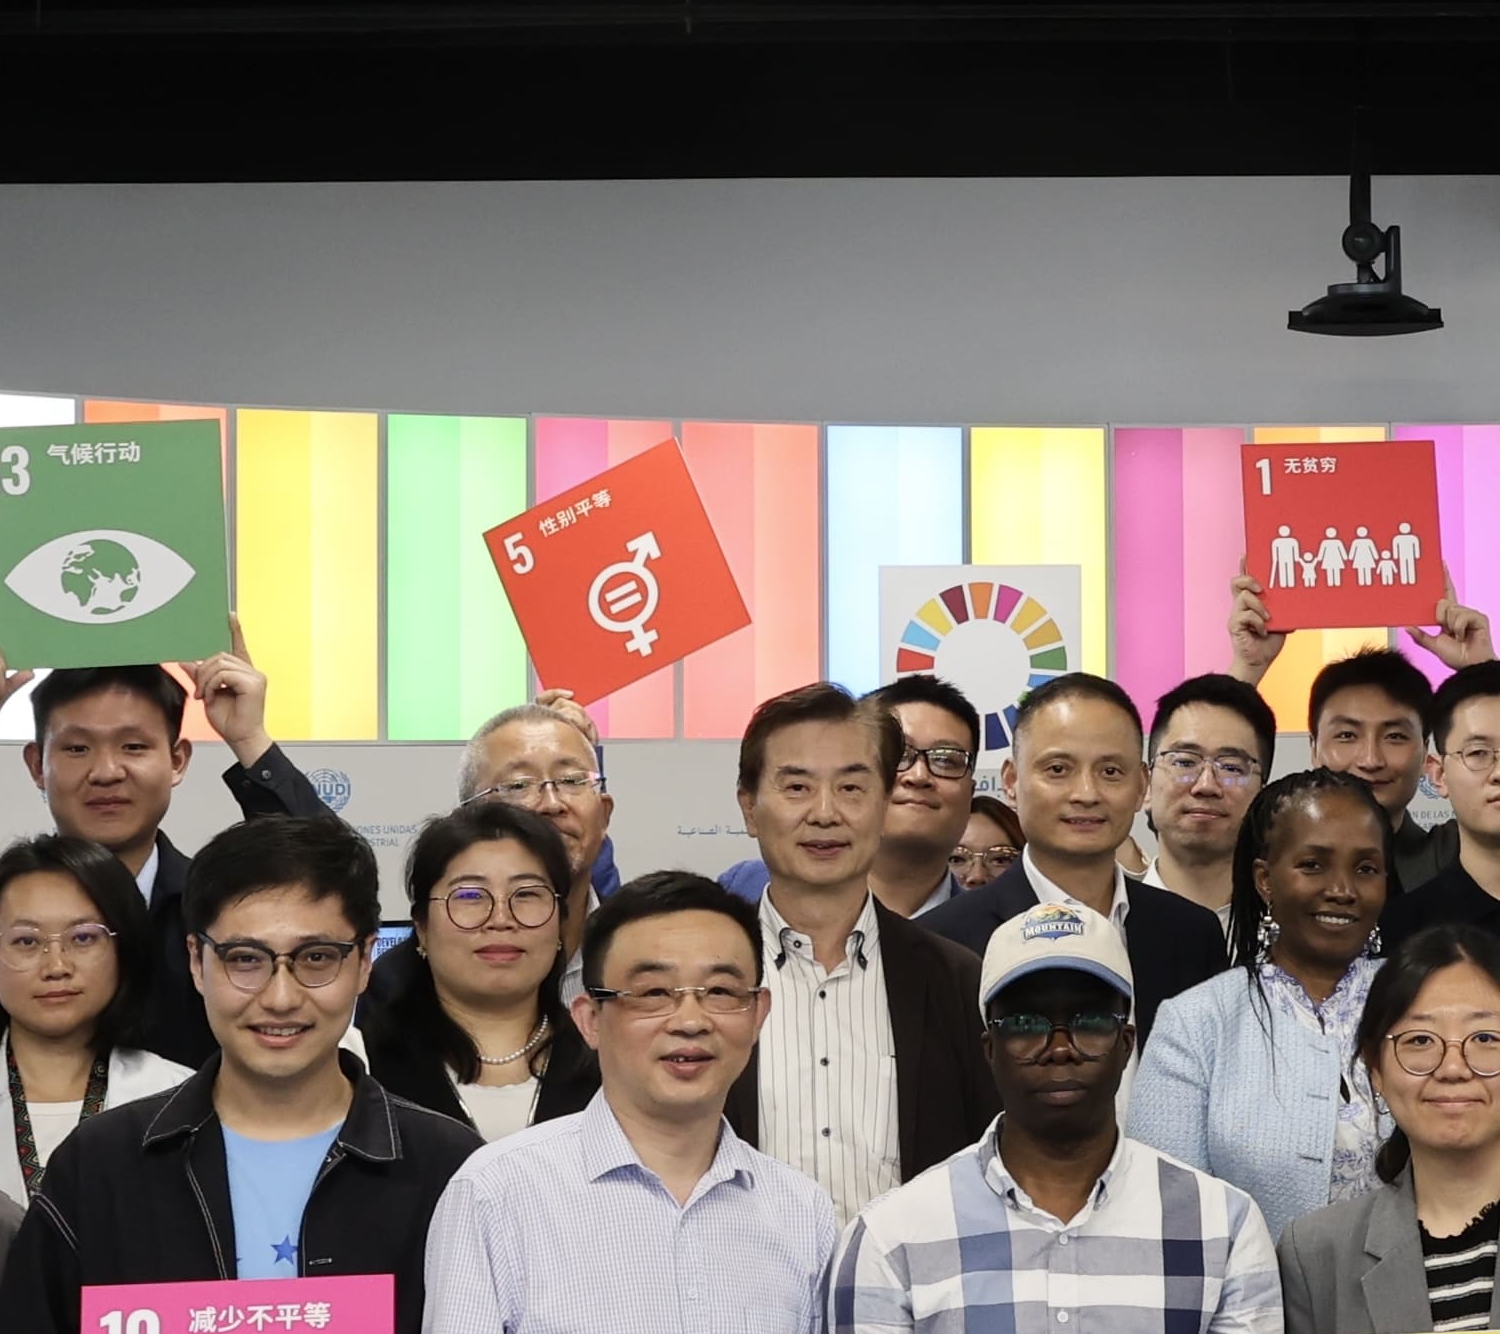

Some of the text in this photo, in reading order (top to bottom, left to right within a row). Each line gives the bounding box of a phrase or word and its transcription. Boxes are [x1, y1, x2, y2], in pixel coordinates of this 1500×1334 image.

[47, 442, 140, 464] 气候行动
[1284, 457, 1336, 473] 无贫穷
[1256, 459, 1272, 494] 1
[538, 491, 612, 537] 性别平等
[504, 533, 533, 573] 5
[383, 825, 417, 835] UNIDAS
[1024, 922, 1084, 940] MOUNTAIN
[189, 1302, 330, 1332] 减少不平等
